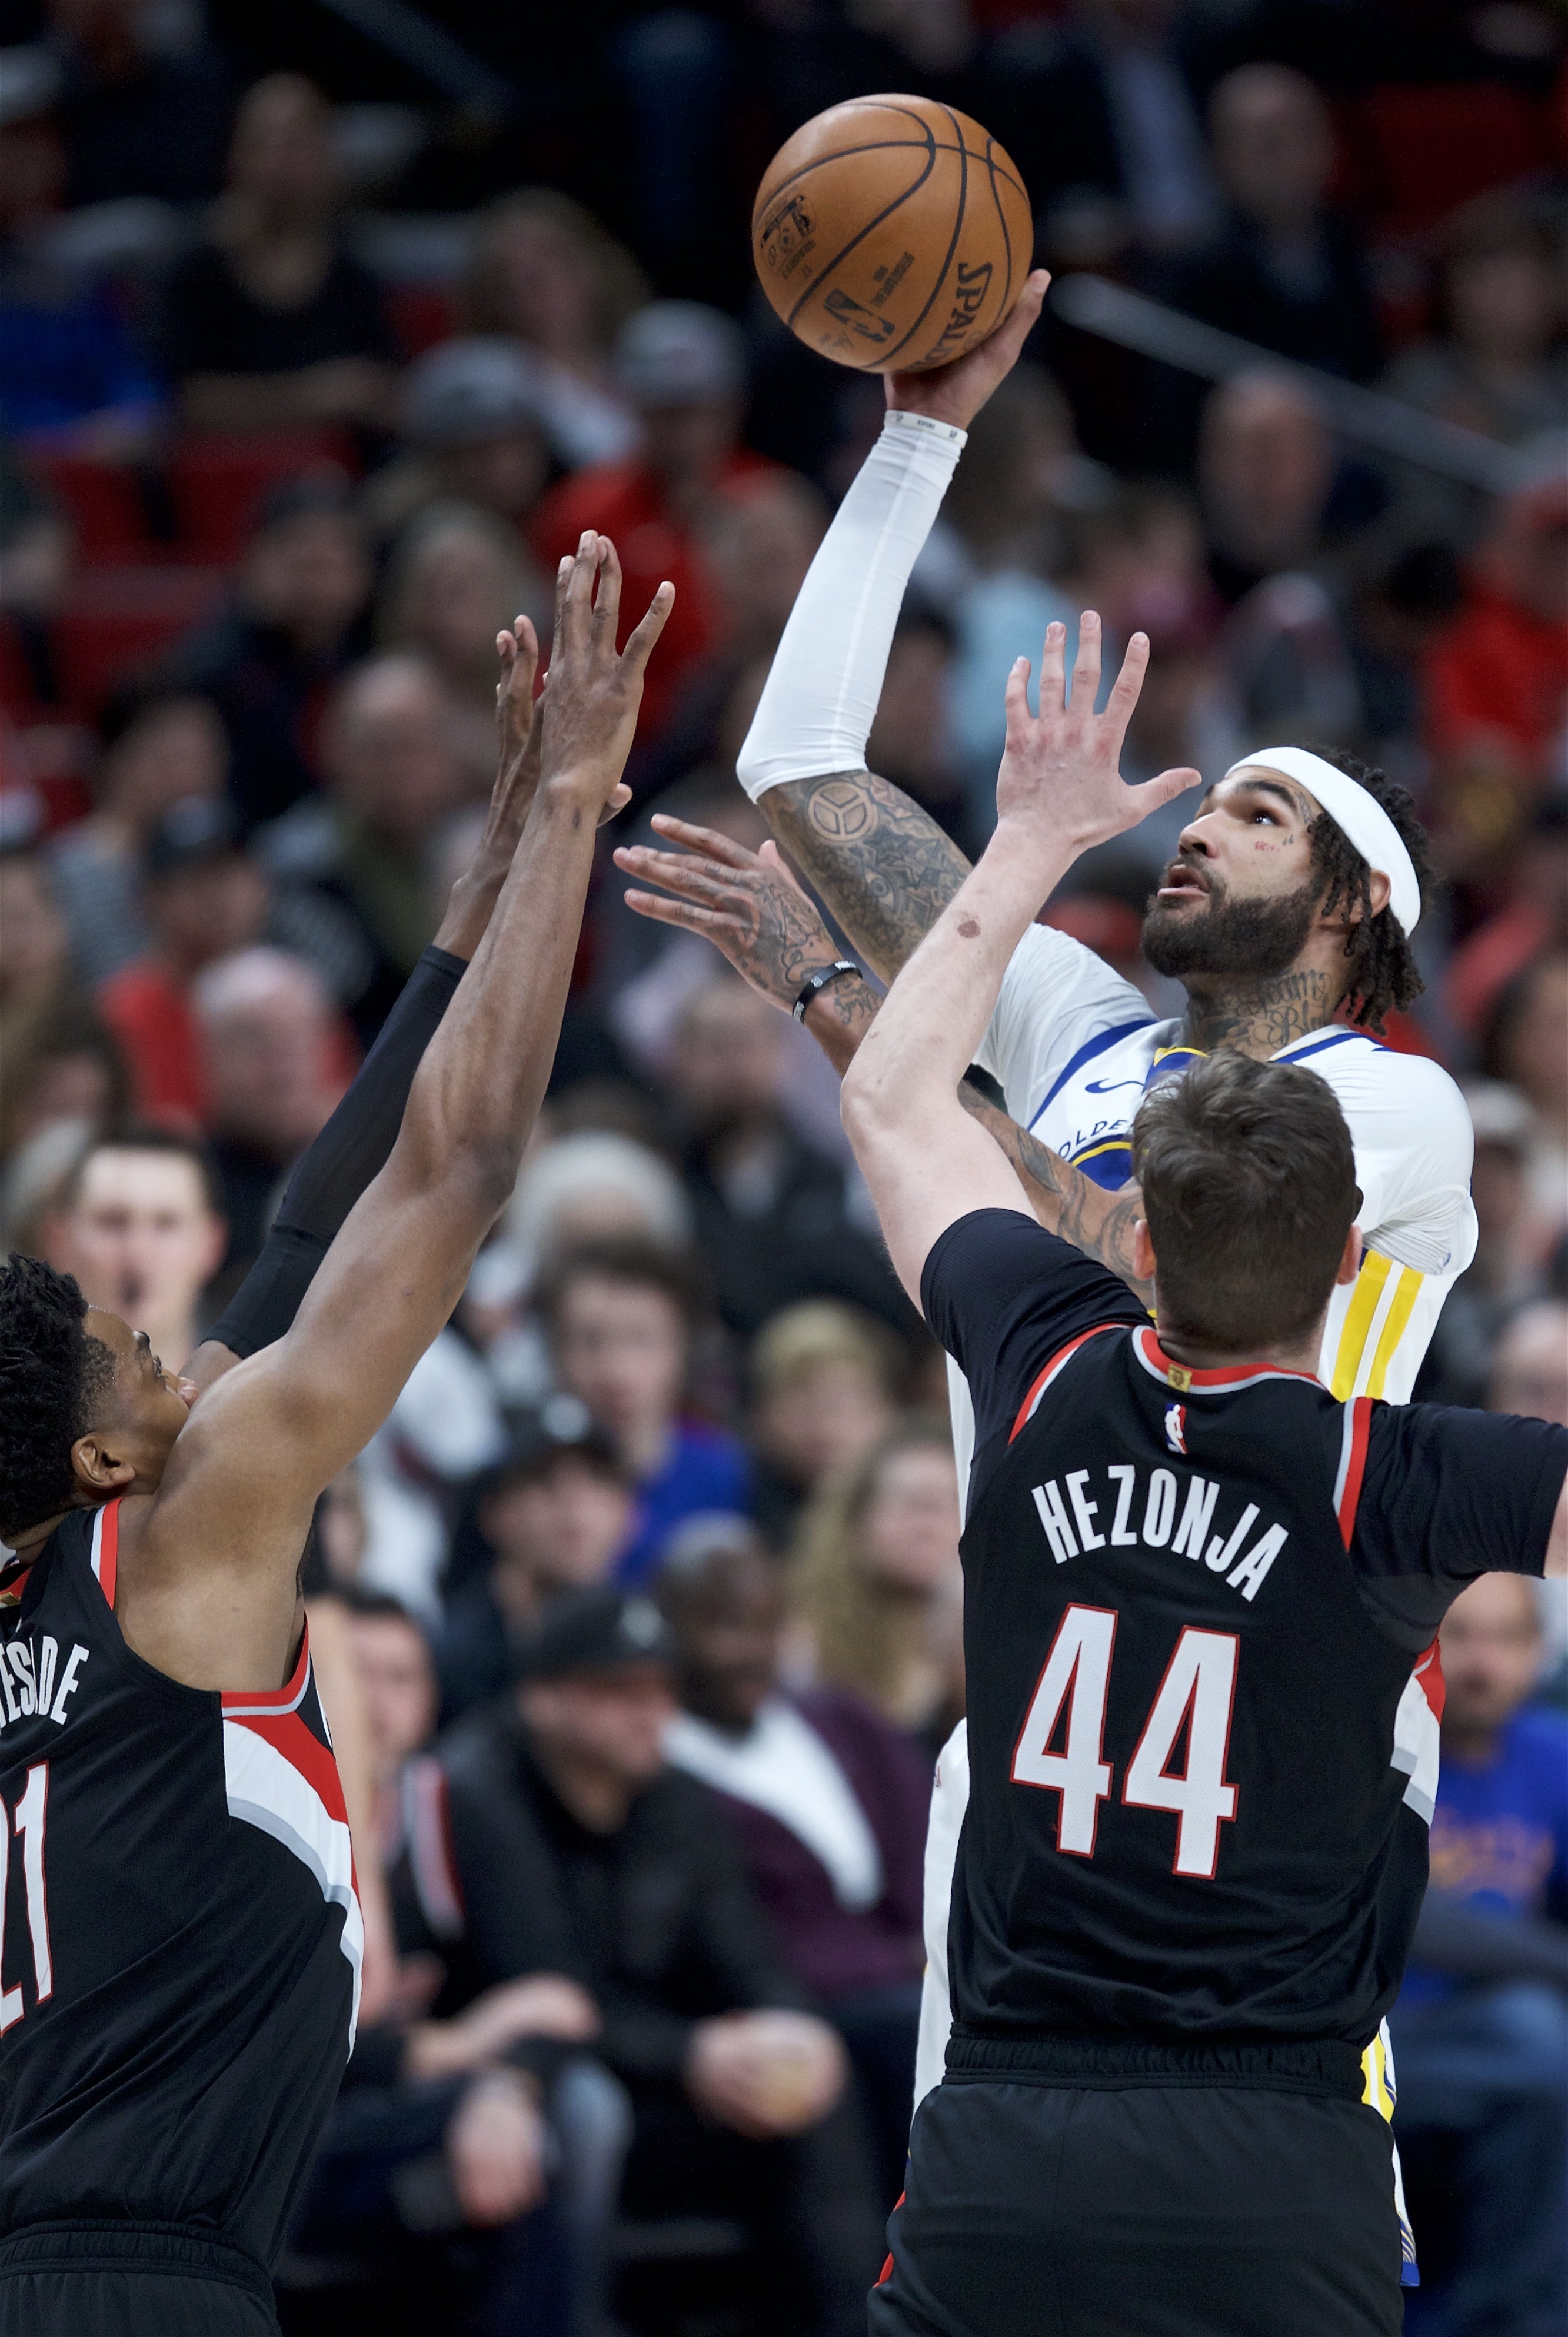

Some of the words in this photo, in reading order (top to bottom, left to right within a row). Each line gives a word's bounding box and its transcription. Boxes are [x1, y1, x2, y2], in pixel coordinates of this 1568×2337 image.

[1058, 1119, 1129, 1158] OLDE
[1031, 1464, 1289, 1602] HEZONJA
[0, 1636, 90, 1729] ESIDE
[1010, 1602, 1239, 1880] 44
